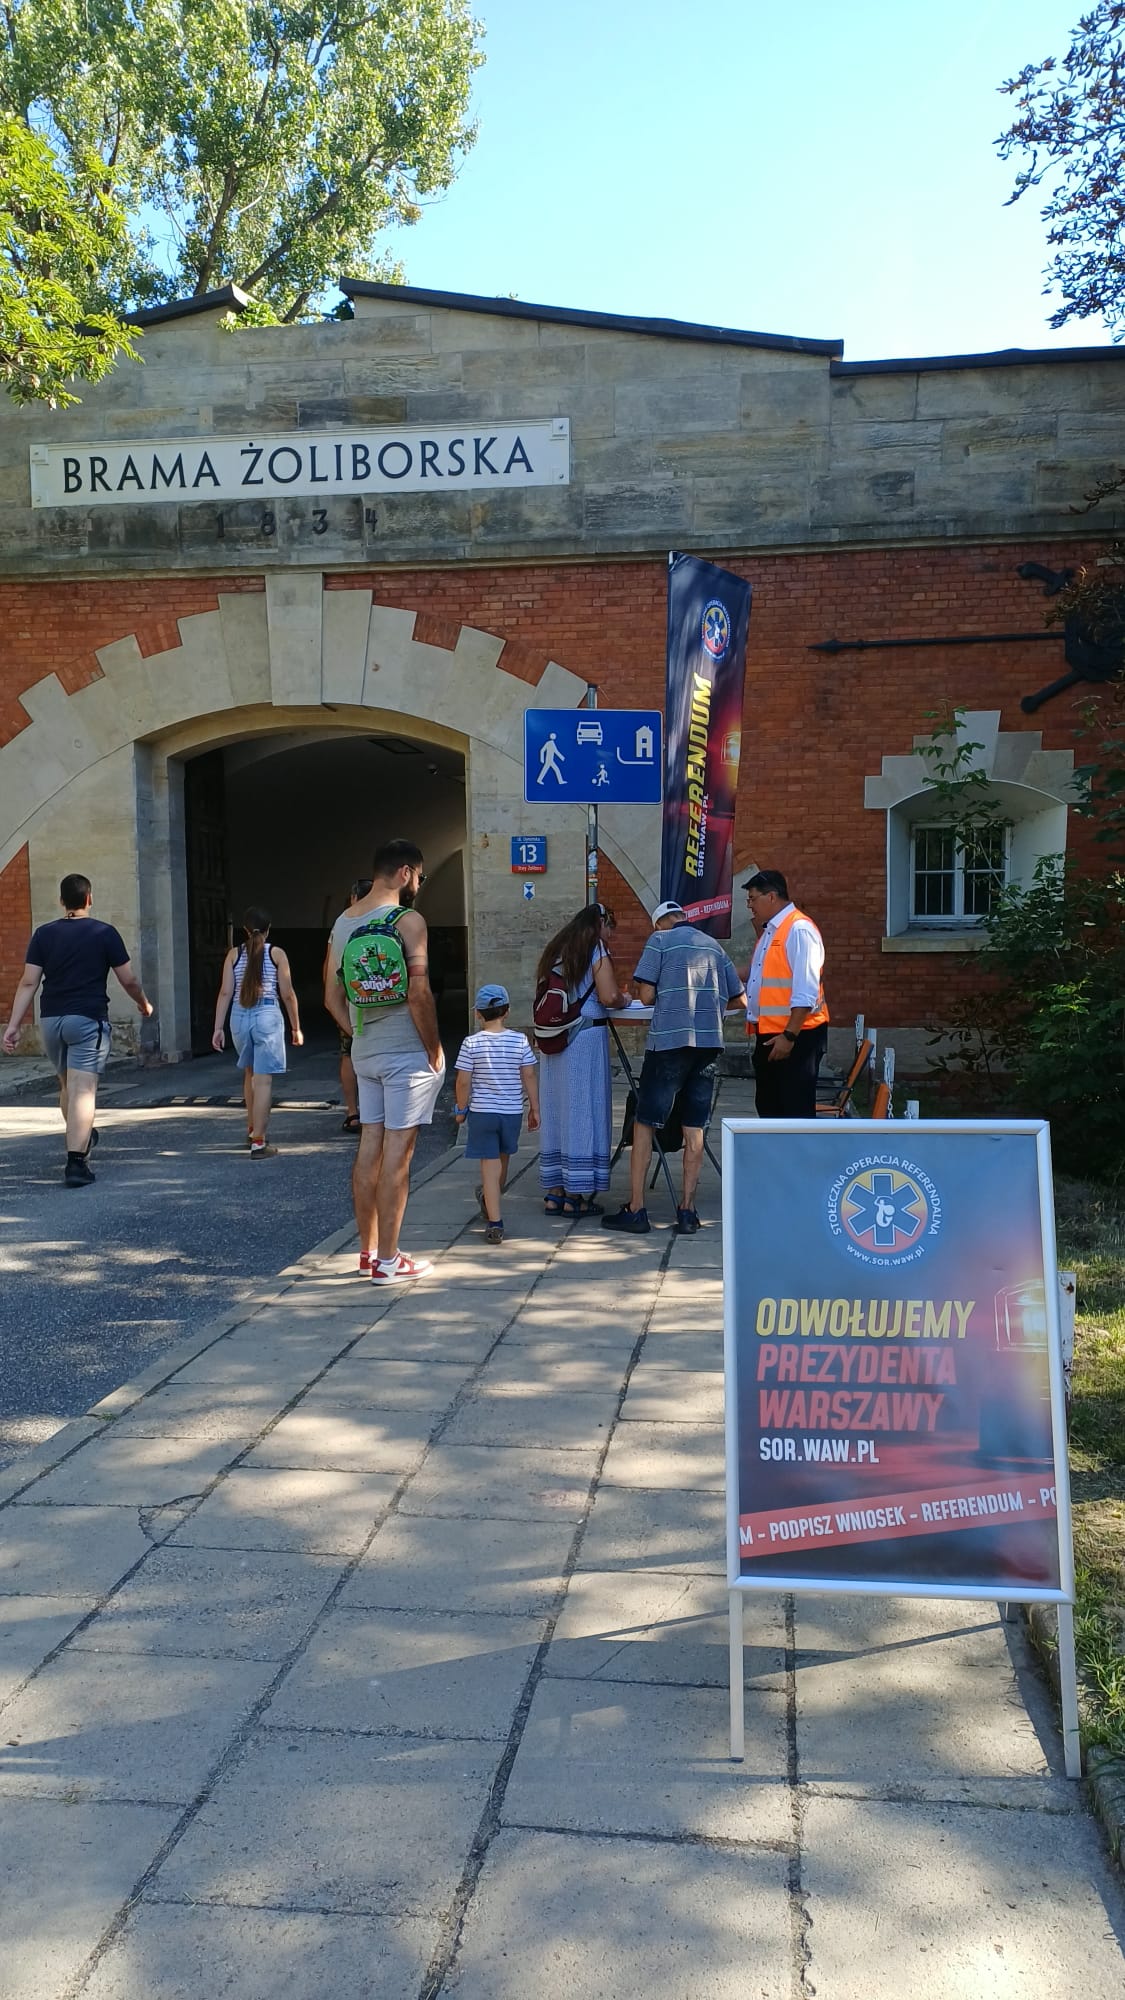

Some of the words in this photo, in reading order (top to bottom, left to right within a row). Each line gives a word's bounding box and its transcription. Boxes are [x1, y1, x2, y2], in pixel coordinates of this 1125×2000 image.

[63, 451, 220, 493] BRAMA
[240, 436, 534, 485] ŻOLIBORSKA
[215, 508, 378, 538] 1834
[685, 673, 712, 878] REFERENDUM
[519, 844, 537, 863] 13
[697, 793, 709, 877] SOR.WAW.PL
[354, 991, 407, 1004] MINECRAFT
[361, 979, 393, 992] BOOM
[828, 1175, 848, 1236] STOŁECZNA
[845, 1155, 900, 1176] OPERACJA
[901, 1159, 943, 1236] REFERENDALNA
[755, 1298, 976, 1339] ODWOŁUJEMY
[757, 1343, 957, 1385] PREZYDENTA
[759, 1389, 945, 1432] WARSZAWY
[759, 1437, 879, 1464] SOR.WAW.PL
[769, 1515, 833, 1542] PODPISZ
[835, 1506, 906, 1533] WNIOSEK
[921, 1491, 1024, 1522] REFERENDUM
